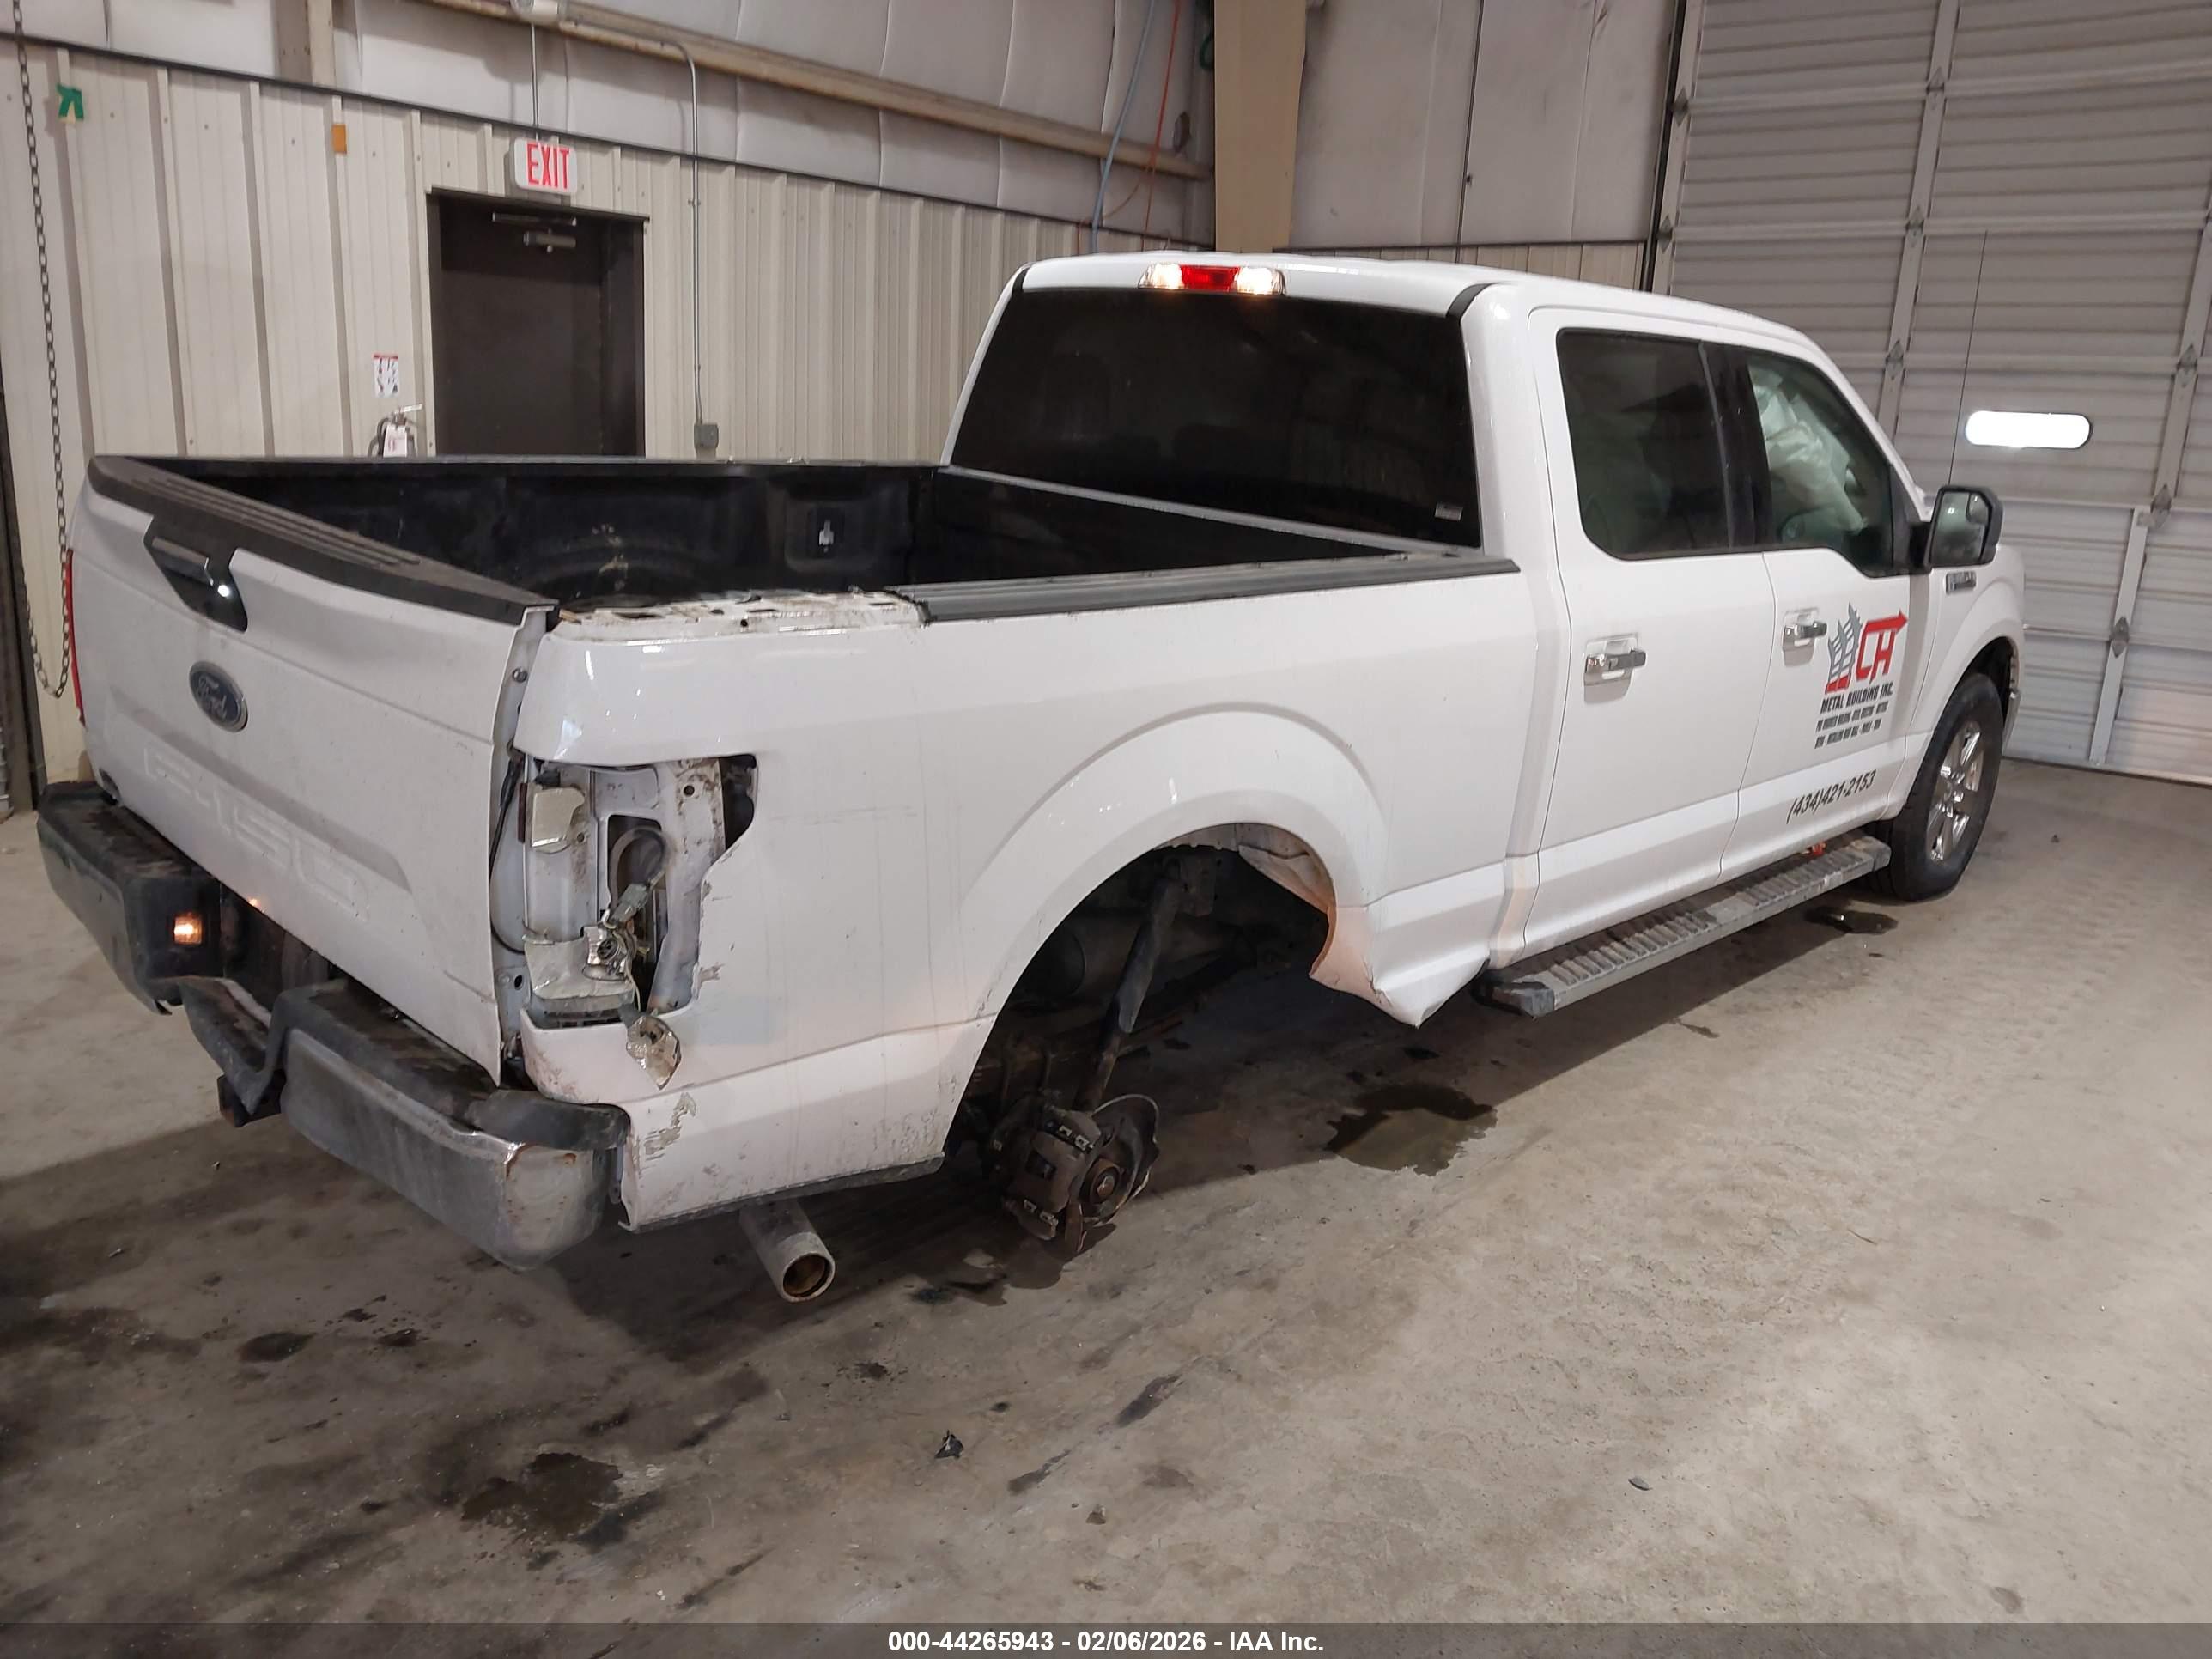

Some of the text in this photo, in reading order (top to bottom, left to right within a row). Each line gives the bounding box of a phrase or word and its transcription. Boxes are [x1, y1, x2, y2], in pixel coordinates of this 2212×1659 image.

[526, 143, 570, 190] EXIT
[193, 671, 234, 724] Ford
[1820, 694, 1844, 714] METAL
[1845, 685, 1880, 708] BUILDING
[1786, 769, 1877, 824] (434)421-2153
